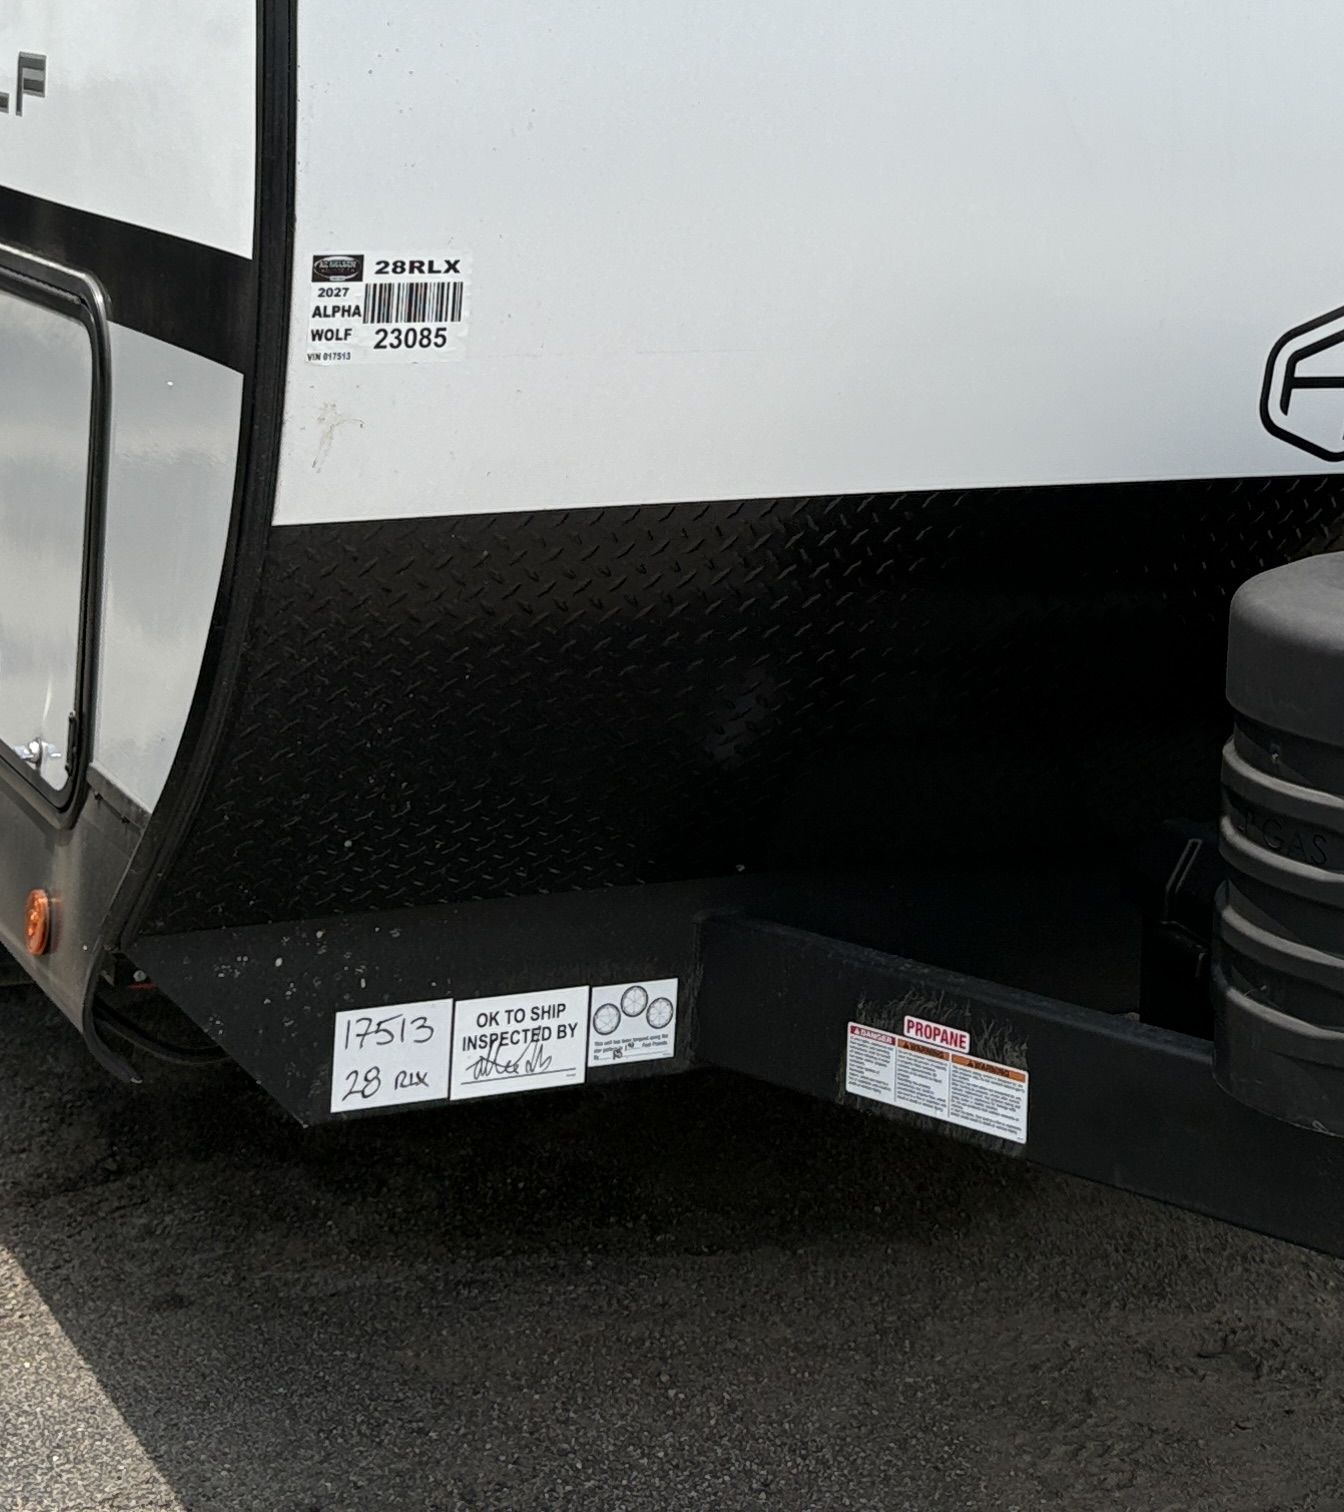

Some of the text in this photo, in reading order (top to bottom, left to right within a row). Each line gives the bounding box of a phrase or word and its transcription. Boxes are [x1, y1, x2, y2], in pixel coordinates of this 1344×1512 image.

[374, 259, 461, 275] 28RLX
[317, 287, 350, 298] 2027
[312, 304, 362, 319] ALPHA
[311, 328, 353, 342] WOLF
[373, 327, 447, 349] 23085
[307, 352, 322, 362] VIN
[476, 1003, 567, 1028] OK TO SHIP
[345, 1014, 434, 1050] 17513
[462, 1022, 578, 1052] INSPECTED BY
[906, 1018, 967, 1050] PROPANE
[342, 1066, 382, 1102] 28
